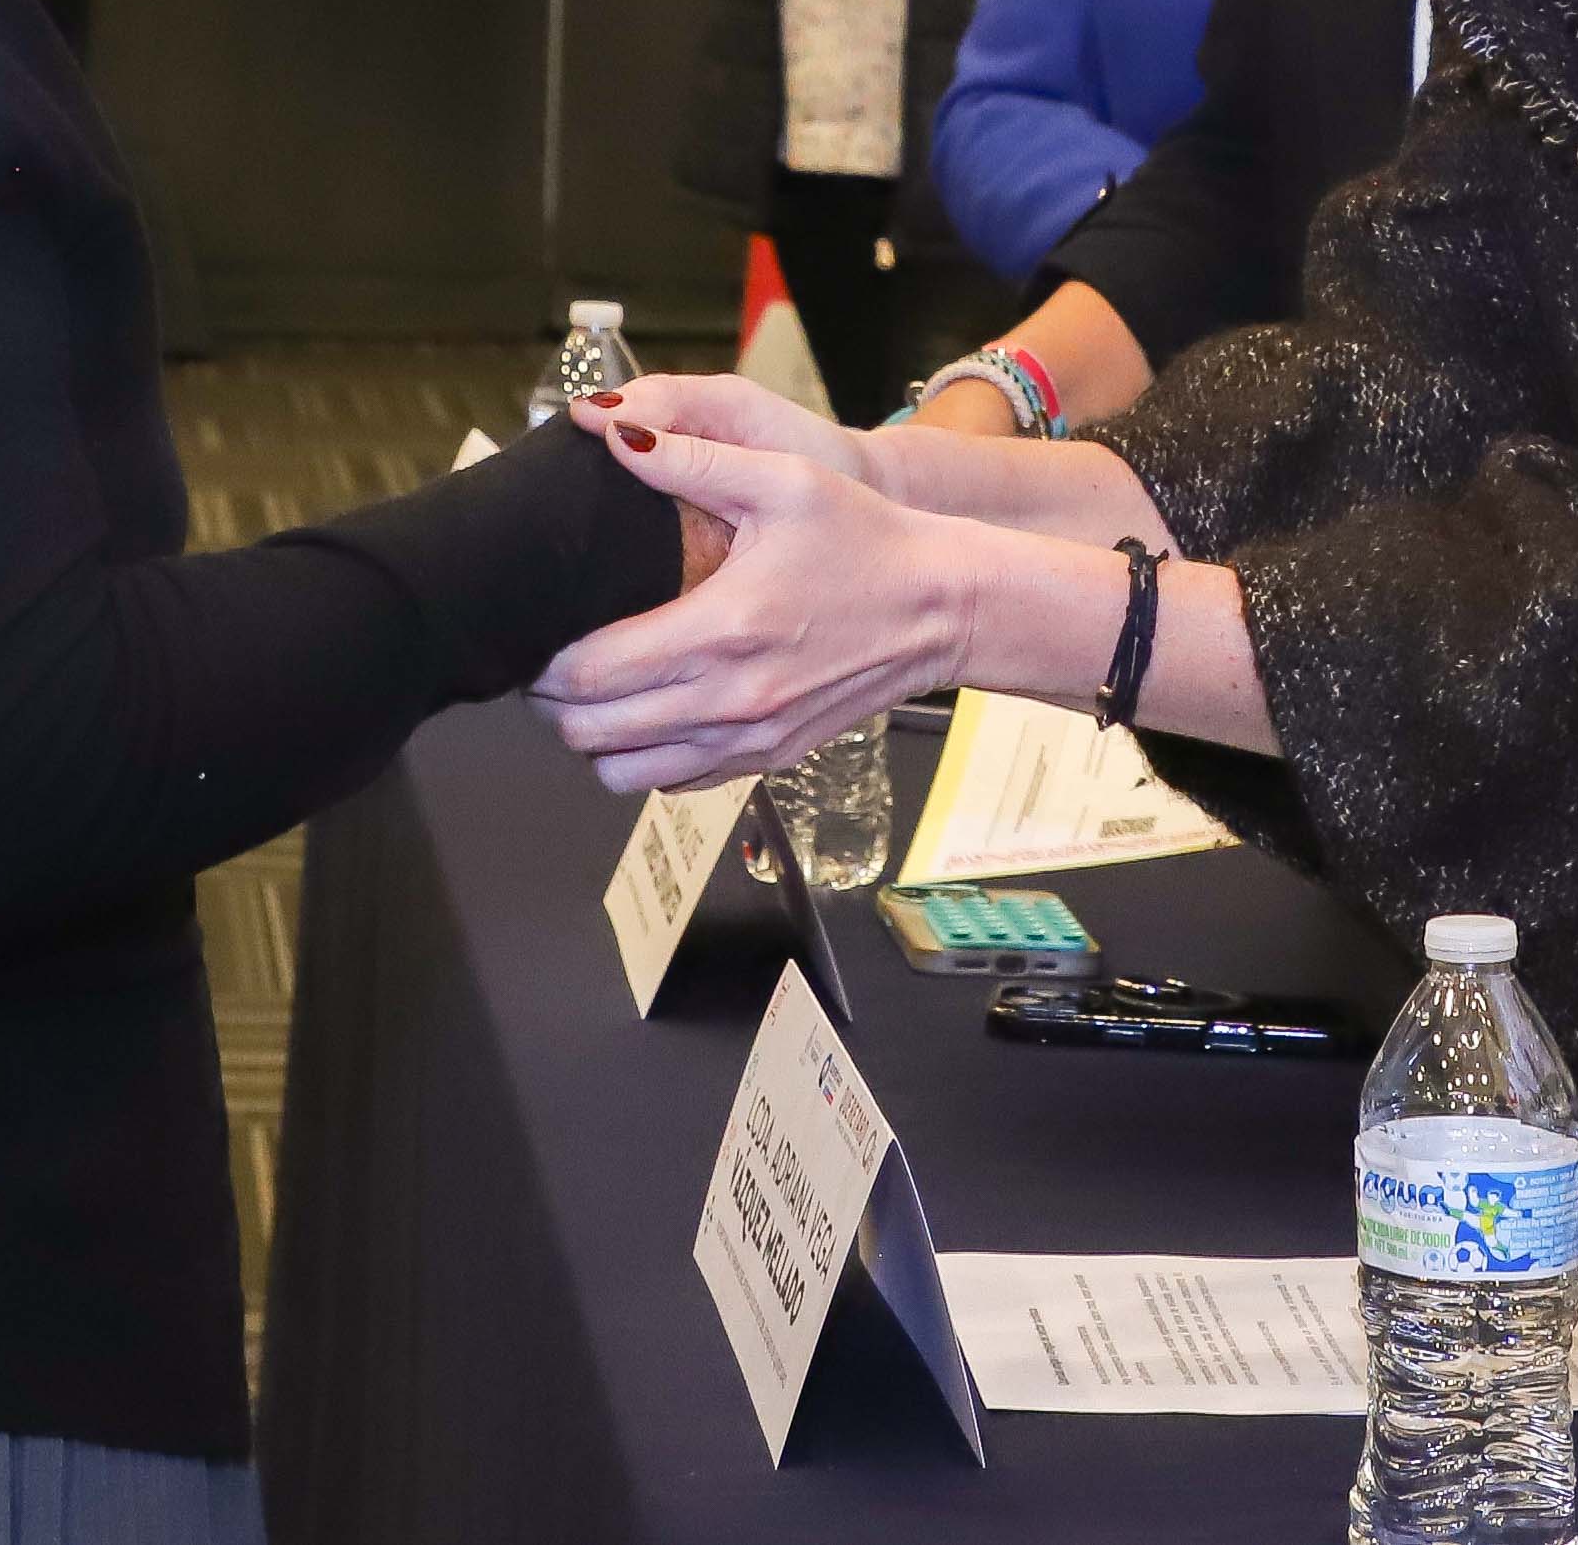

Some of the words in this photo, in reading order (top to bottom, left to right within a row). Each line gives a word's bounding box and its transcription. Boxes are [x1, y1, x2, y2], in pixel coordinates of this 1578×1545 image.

[729, 1146, 771, 1252] VÁZQUEZ
[762, 1218, 806, 1327] MELLADO
[746, 1086, 776, 1165] LCDA.
[769, 1133, 815, 1240] ADRIANA
[806, 1199, 838, 1286] VEGA
[1411, 1230, 1422, 1246] DE
[1422, 1231, 1451, 1249] SODIO
